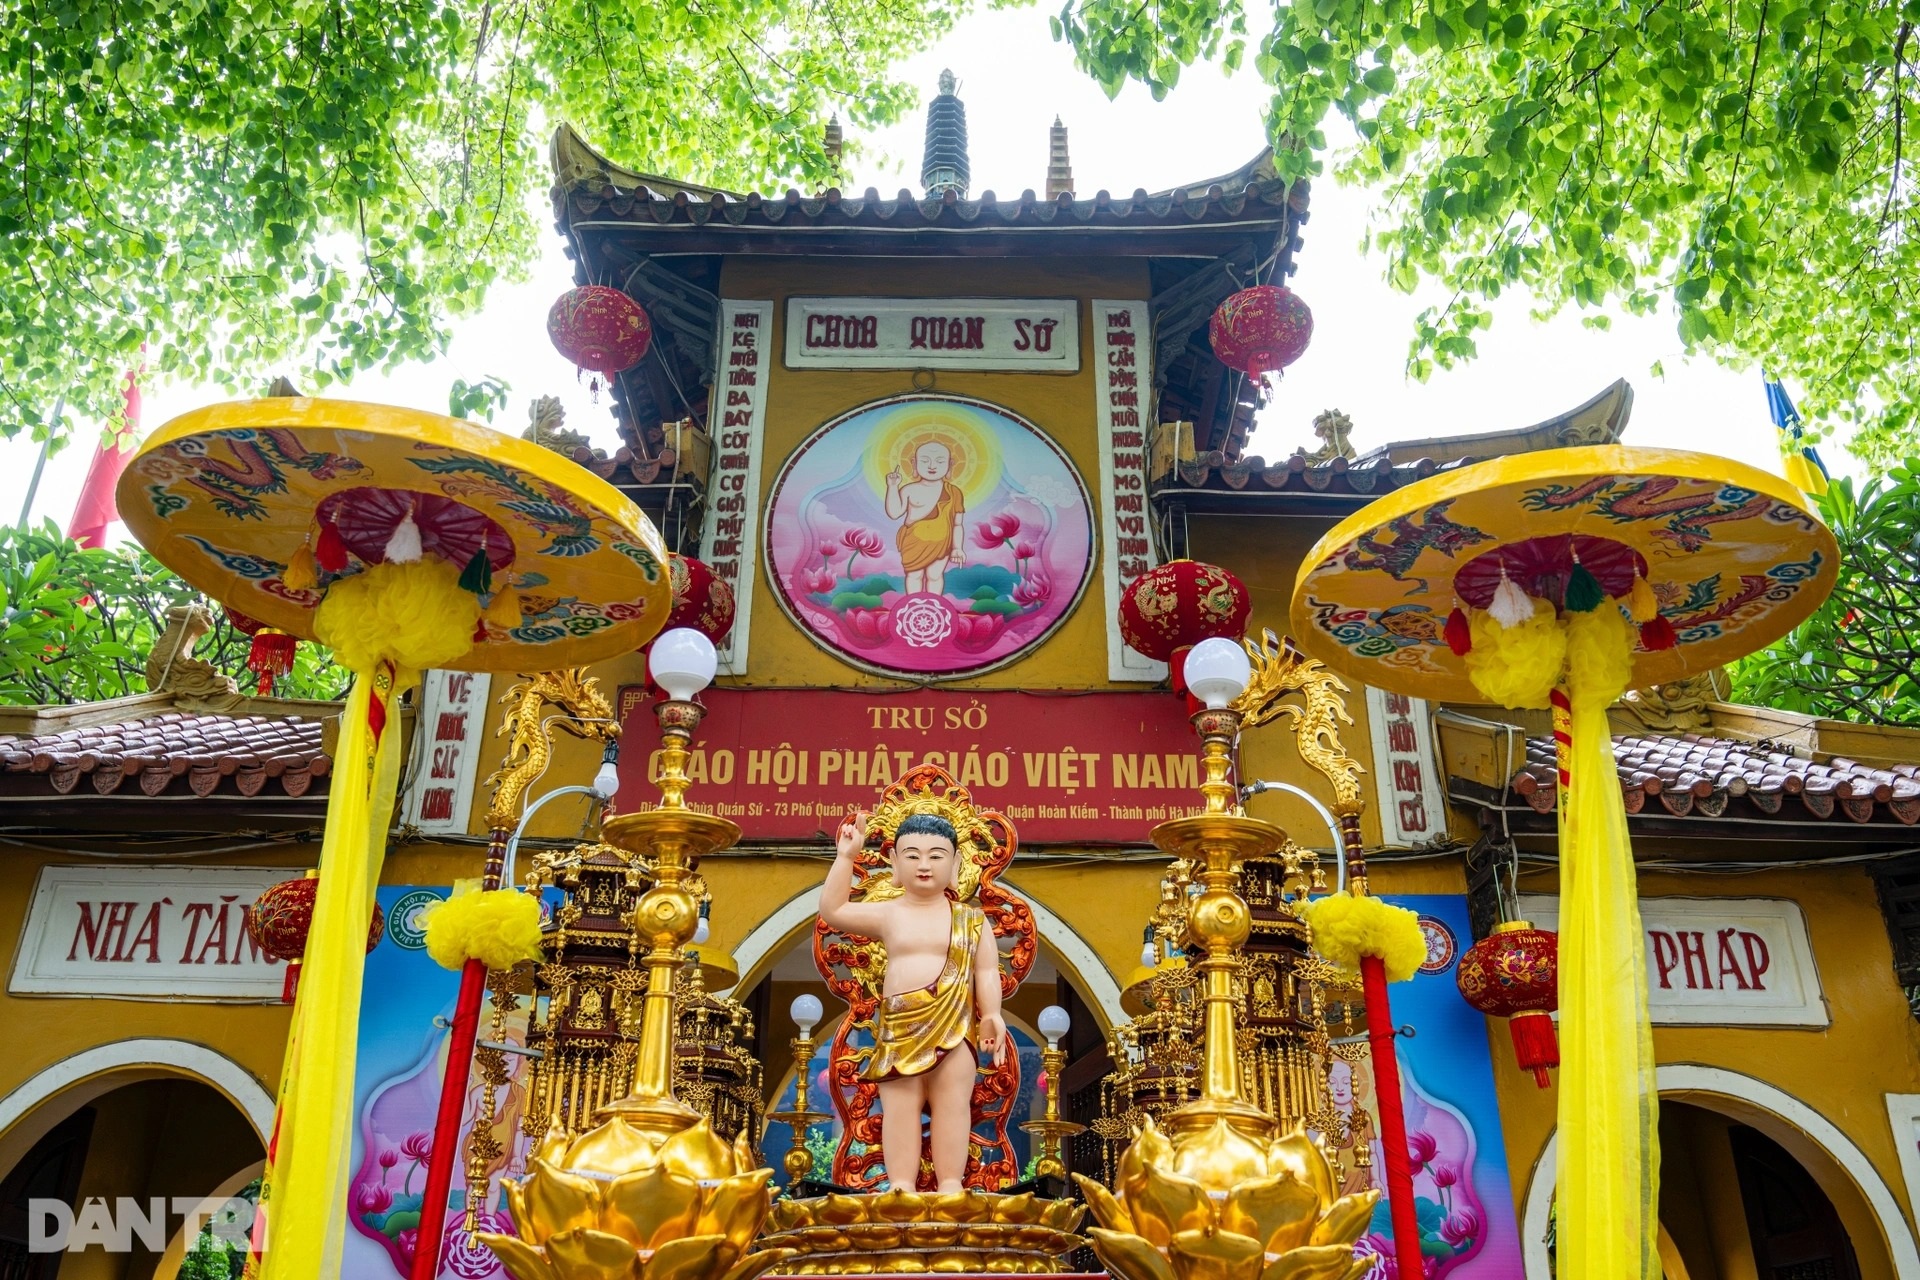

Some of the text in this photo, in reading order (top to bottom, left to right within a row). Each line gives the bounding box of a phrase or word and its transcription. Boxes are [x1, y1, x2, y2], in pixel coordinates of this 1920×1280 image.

[732, 331, 755, 349] KỆ
[805, 314, 1059, 352] CHÙA QUÁN SỨ
[727, 390, 751, 406] BA
[1113, 453, 1142, 470] NAM
[1114, 474, 1142, 490] MÔ
[867, 699, 988, 735] TRỤ SỞ
[647, 740, 736, 785] GÁO
[746, 742, 809, 793] HỘI
[818, 743, 914, 793] PHẬT
[1023, 745, 1101, 795] VIỆT
[1112, 753, 1199, 790] NAM
[716, 801, 745, 817] Quán
[748, 801, 764, 817] Sứ
[774, 803, 789, 817] 73
[791, 801, 815, 817] Phố
[815, 802, 844, 817] Quán
[1006, 804, 1035, 822] Quận
[1038, 803, 1067, 819] Hoàn
[1069, 802, 1099, 819] Kiếm
[1109, 805, 1143, 820] Thành
[1146, 803, 1166, 821] phố
[1169, 806, 1184, 819] Hà
[66, 895, 281, 965] NHÀ TĂN
[1647, 926, 1771, 991] PHÁP
